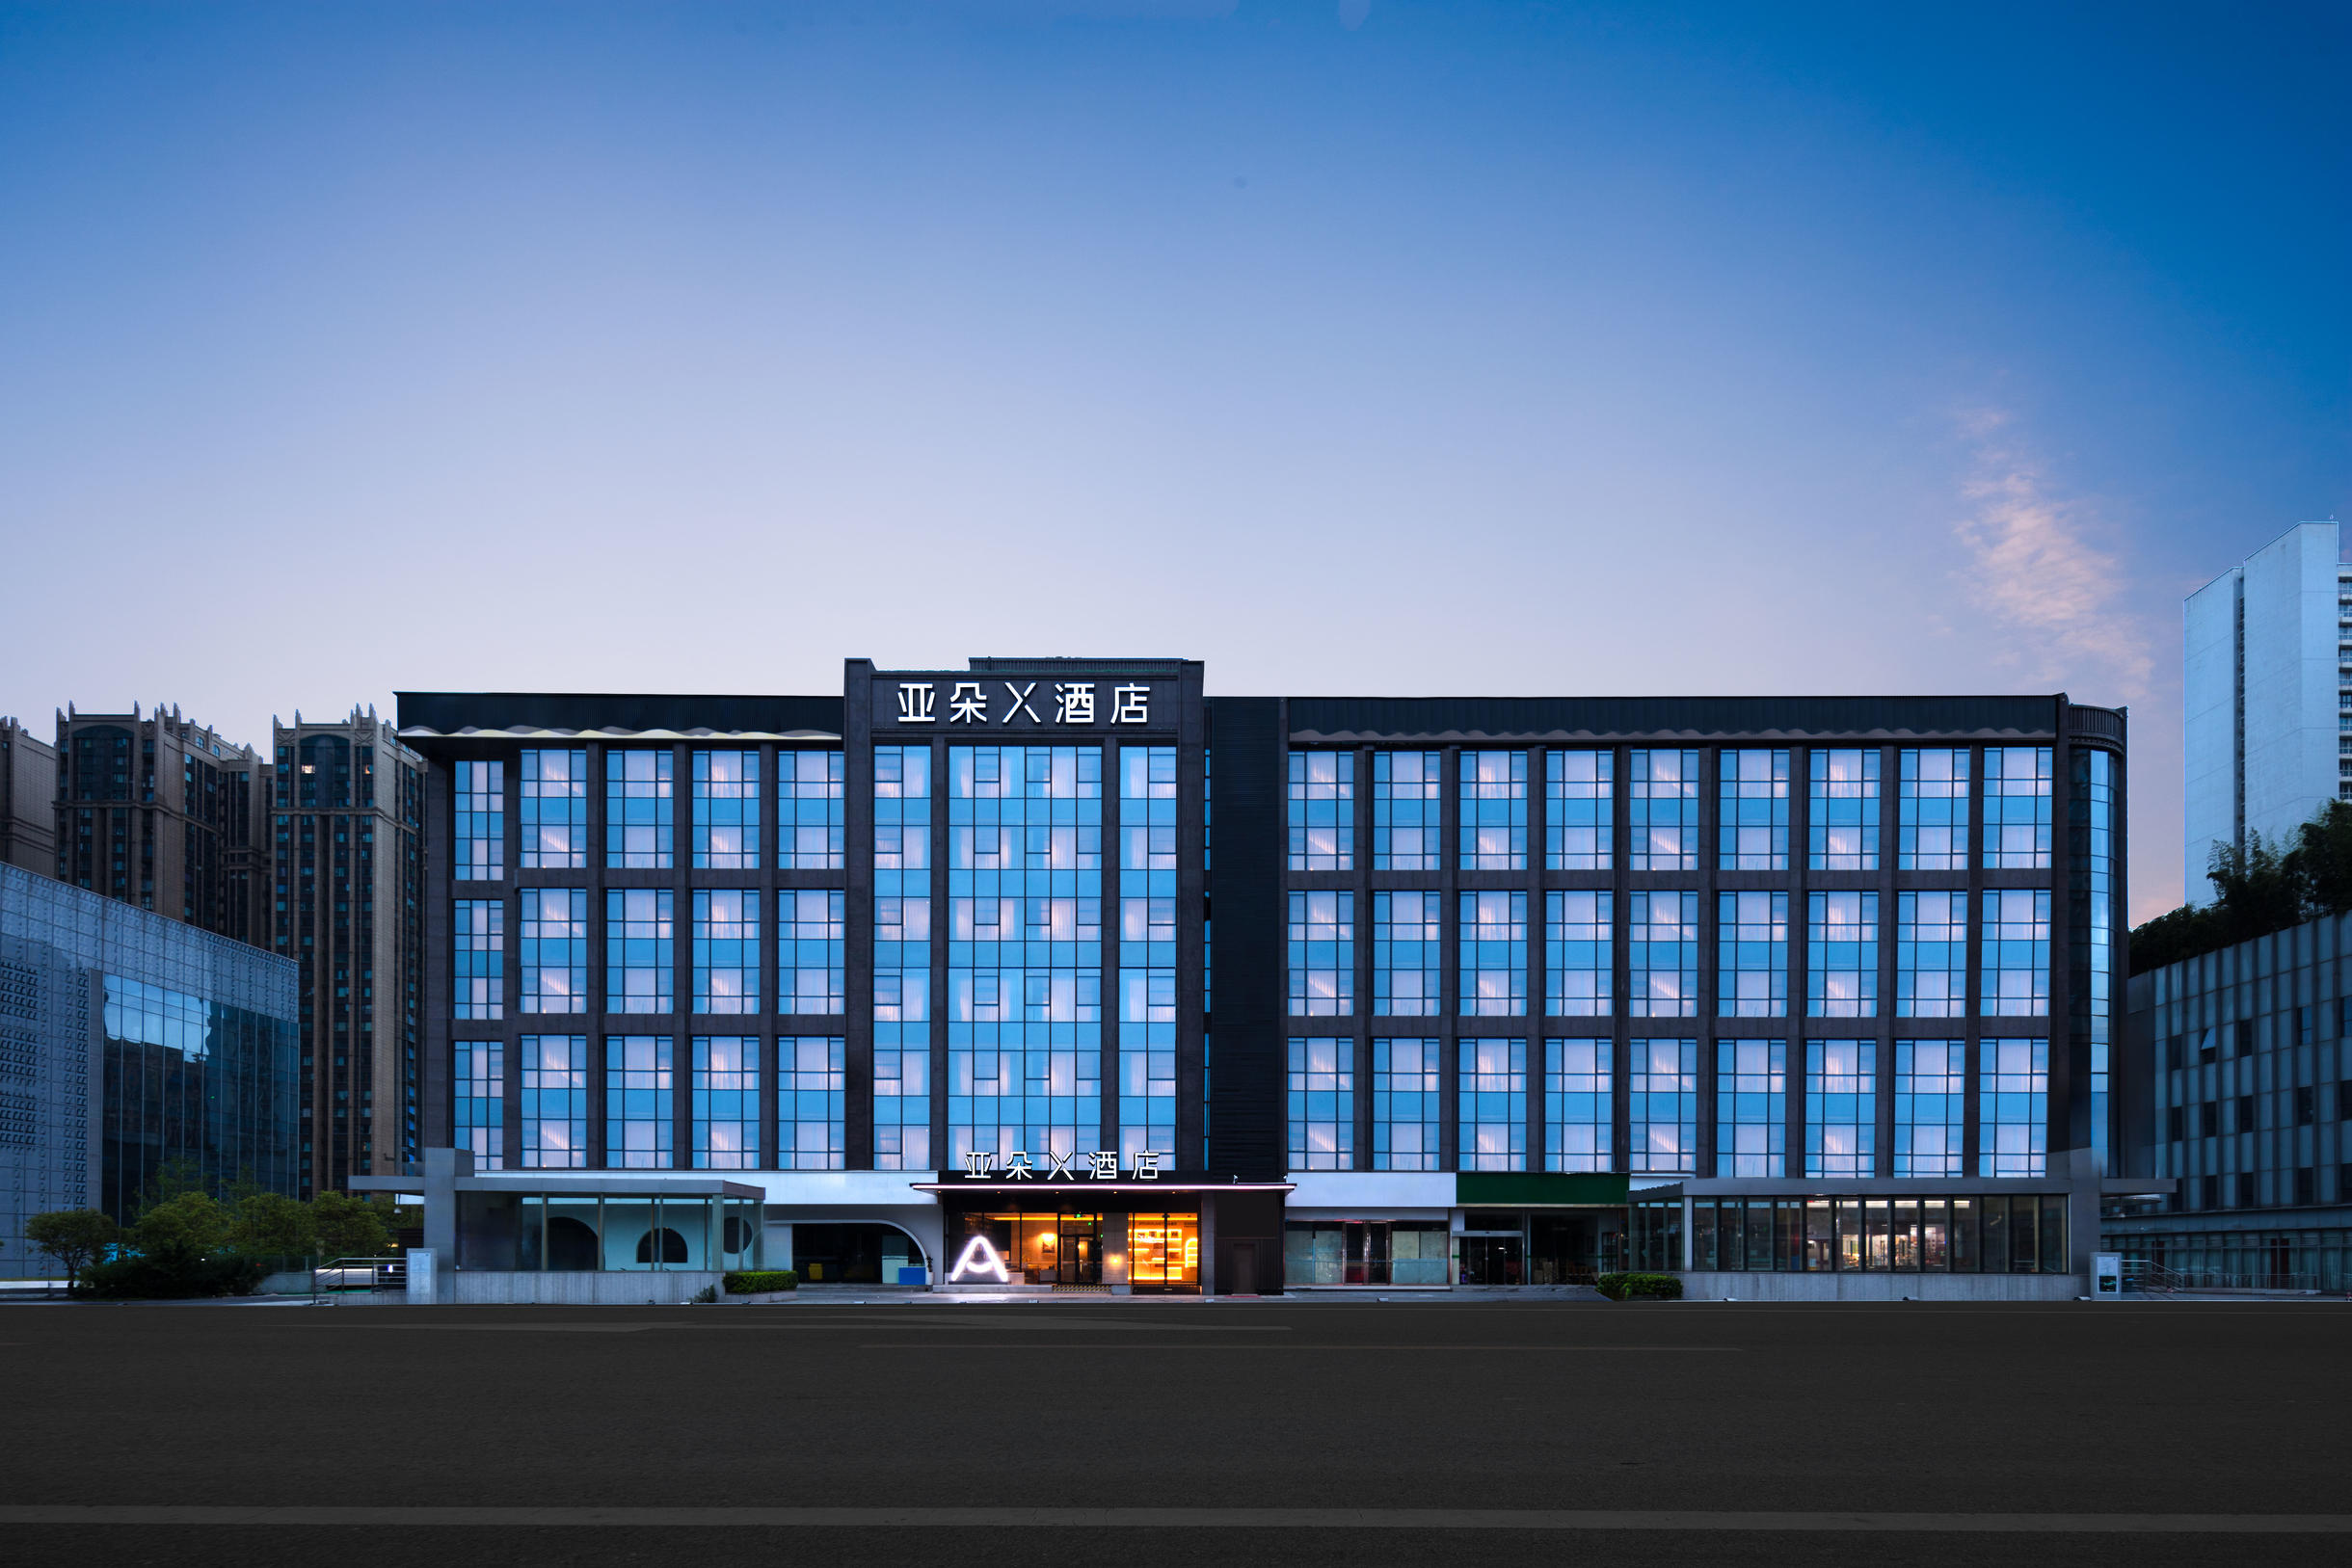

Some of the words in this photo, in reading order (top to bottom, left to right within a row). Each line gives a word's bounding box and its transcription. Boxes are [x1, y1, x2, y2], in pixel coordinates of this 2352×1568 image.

[897, 682, 1150, 724] 亚朵X酒店
[964, 1150, 1160, 1181] 亚朵X酒店
